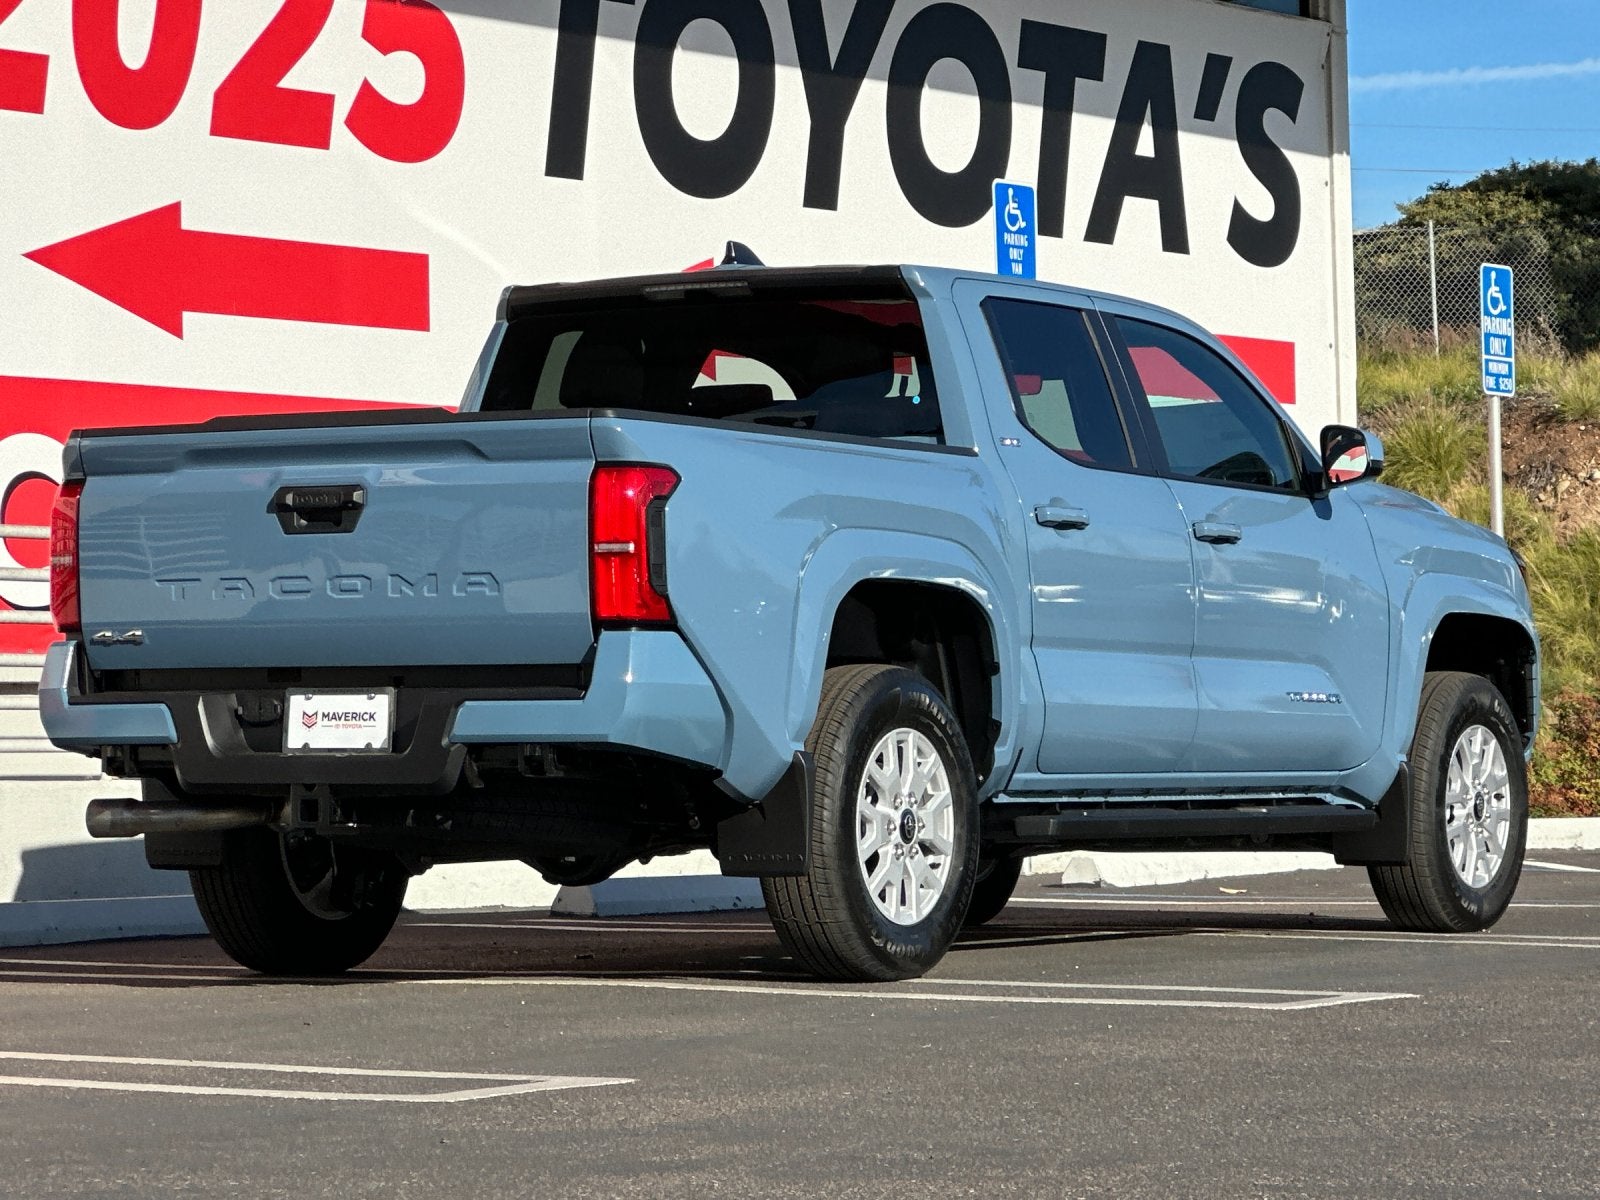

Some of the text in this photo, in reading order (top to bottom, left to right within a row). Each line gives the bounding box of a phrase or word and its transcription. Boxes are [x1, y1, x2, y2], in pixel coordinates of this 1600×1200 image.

[0, 0, 1305, 268] 025 TOYOTA'S
[1004, 232, 1028, 247] PARKING
[1009, 247, 1023, 260] ONLY
[1011, 262, 1023, 275] VAN
[1484, 316, 1512, 336] PARKING
[1490, 336, 1507, 355] ONLY
[154, 571, 501, 601] TACOMA
[321, 711, 376, 722] MAVERICK
